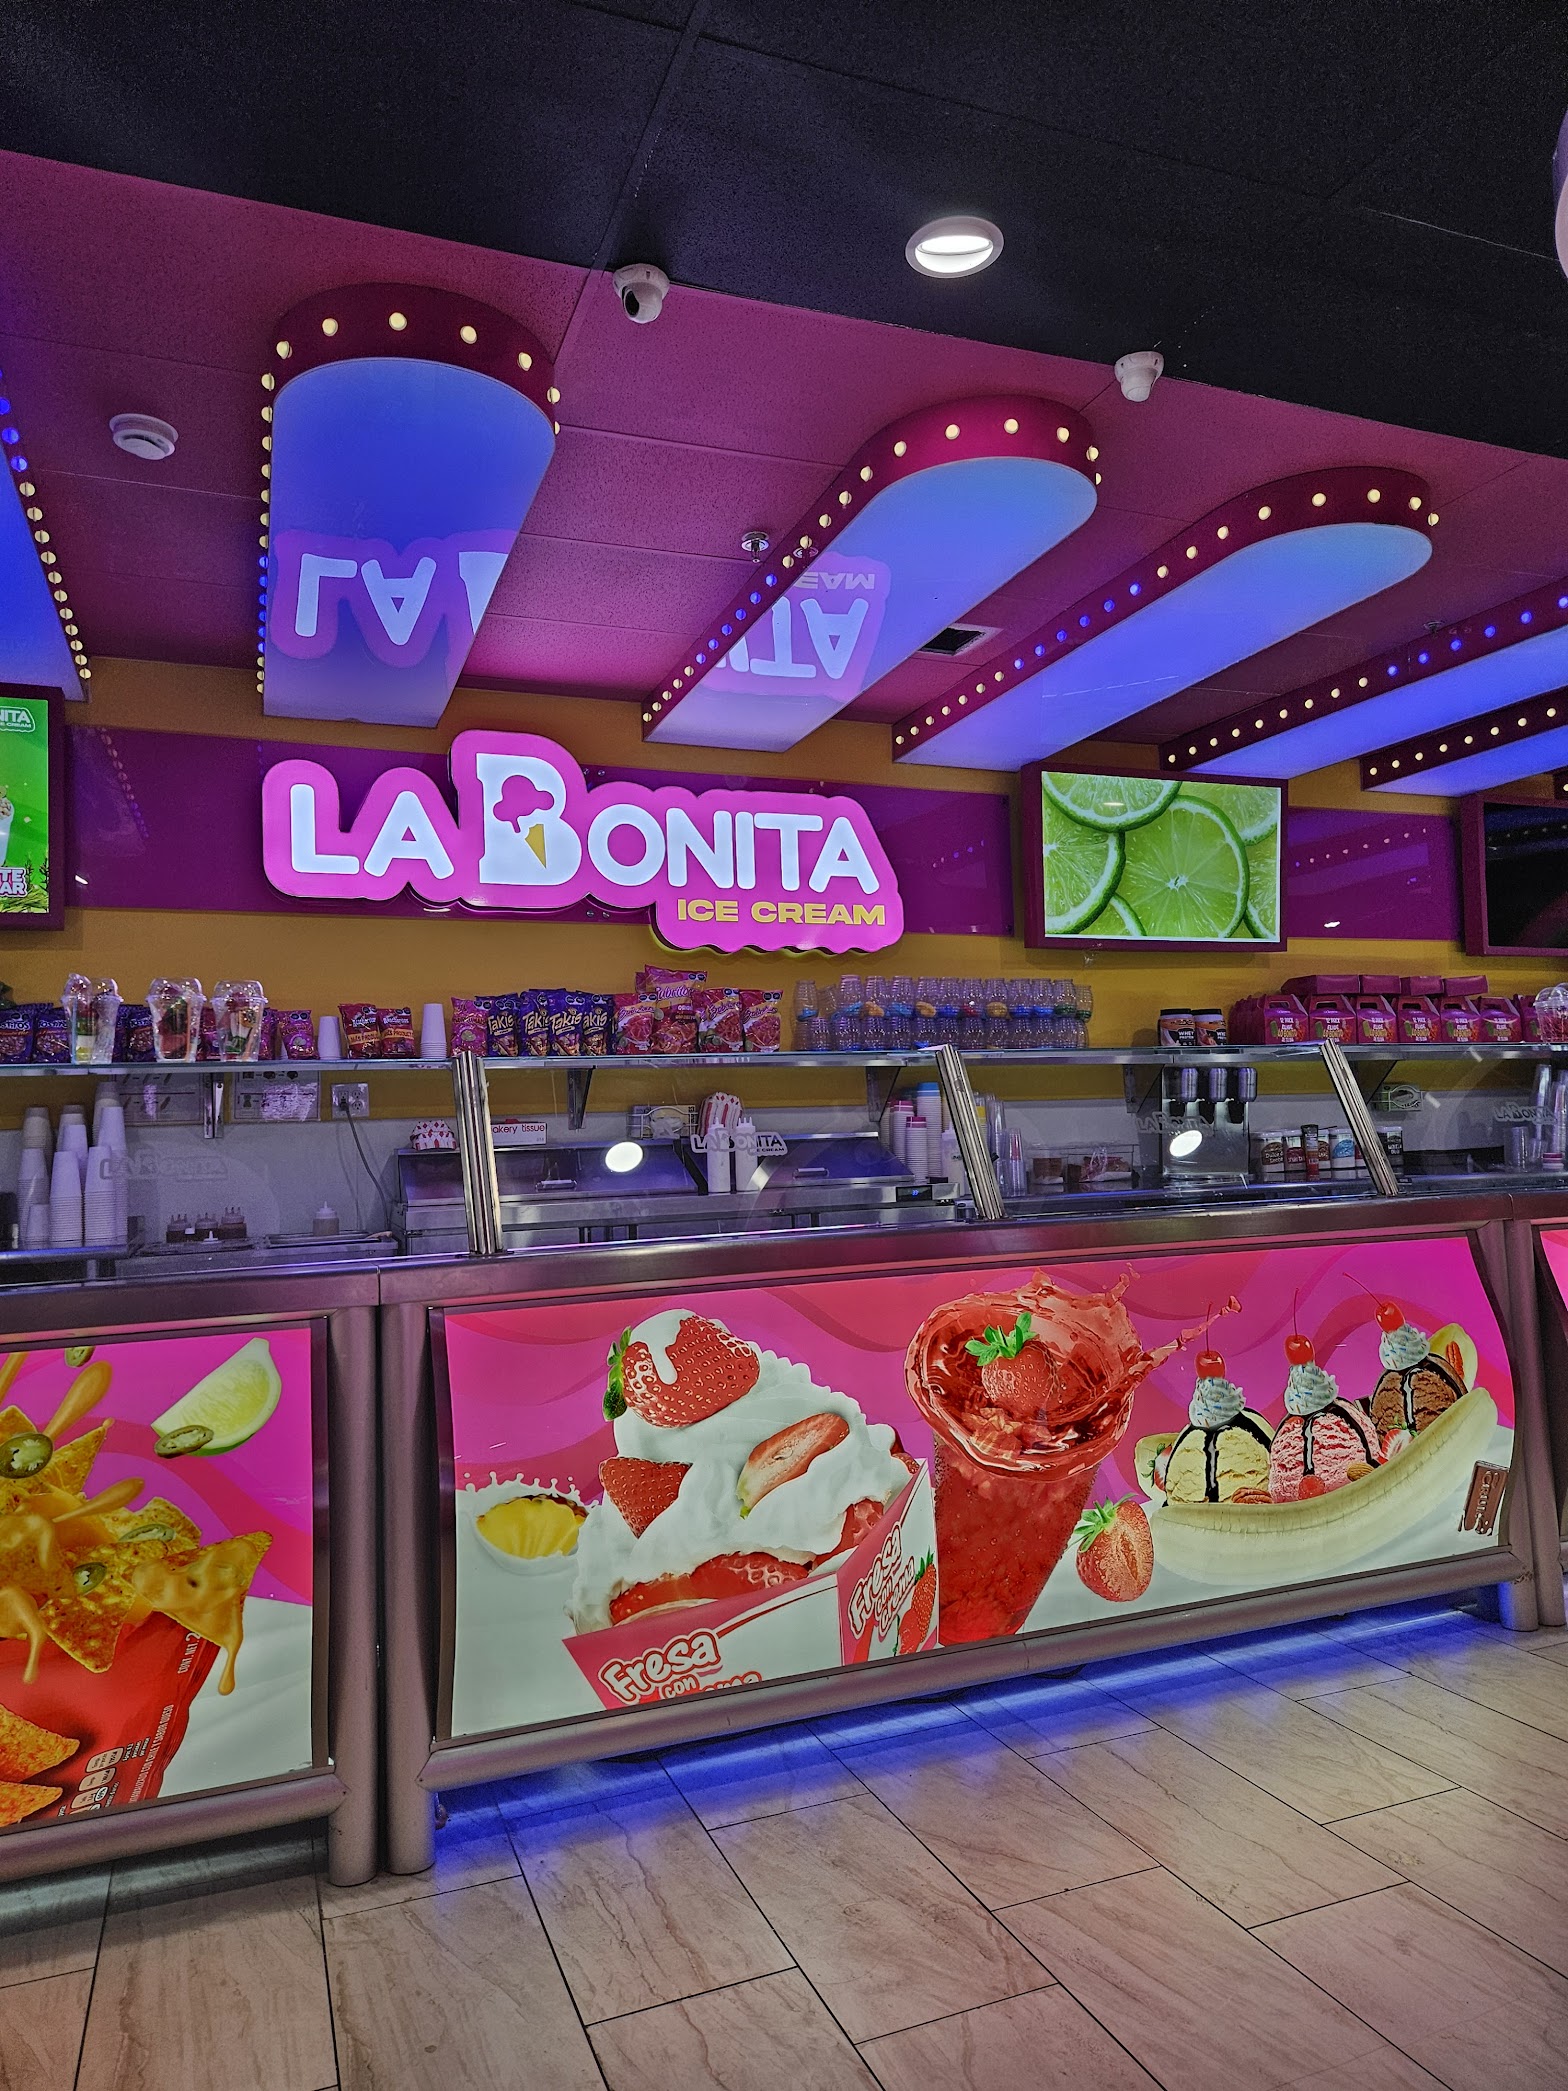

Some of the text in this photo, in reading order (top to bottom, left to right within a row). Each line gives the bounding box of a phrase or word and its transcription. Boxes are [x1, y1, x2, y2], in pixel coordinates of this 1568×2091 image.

[290, 753, 880, 895] LA BONITA
[678, 899, 886, 926] ICE CREAM
[488, 1014, 514, 1035] Takis
[550, 1010, 582, 1034] Takis
[583, 1011, 607, 1030] akis
[492, 1124, 544, 1134] akery tissue
[850, 1525, 901, 1635] Fresa
[875, 1577, 892, 1616] con
[602, 1632, 720, 1701] Fresa
[663, 1674, 698, 1698] con
